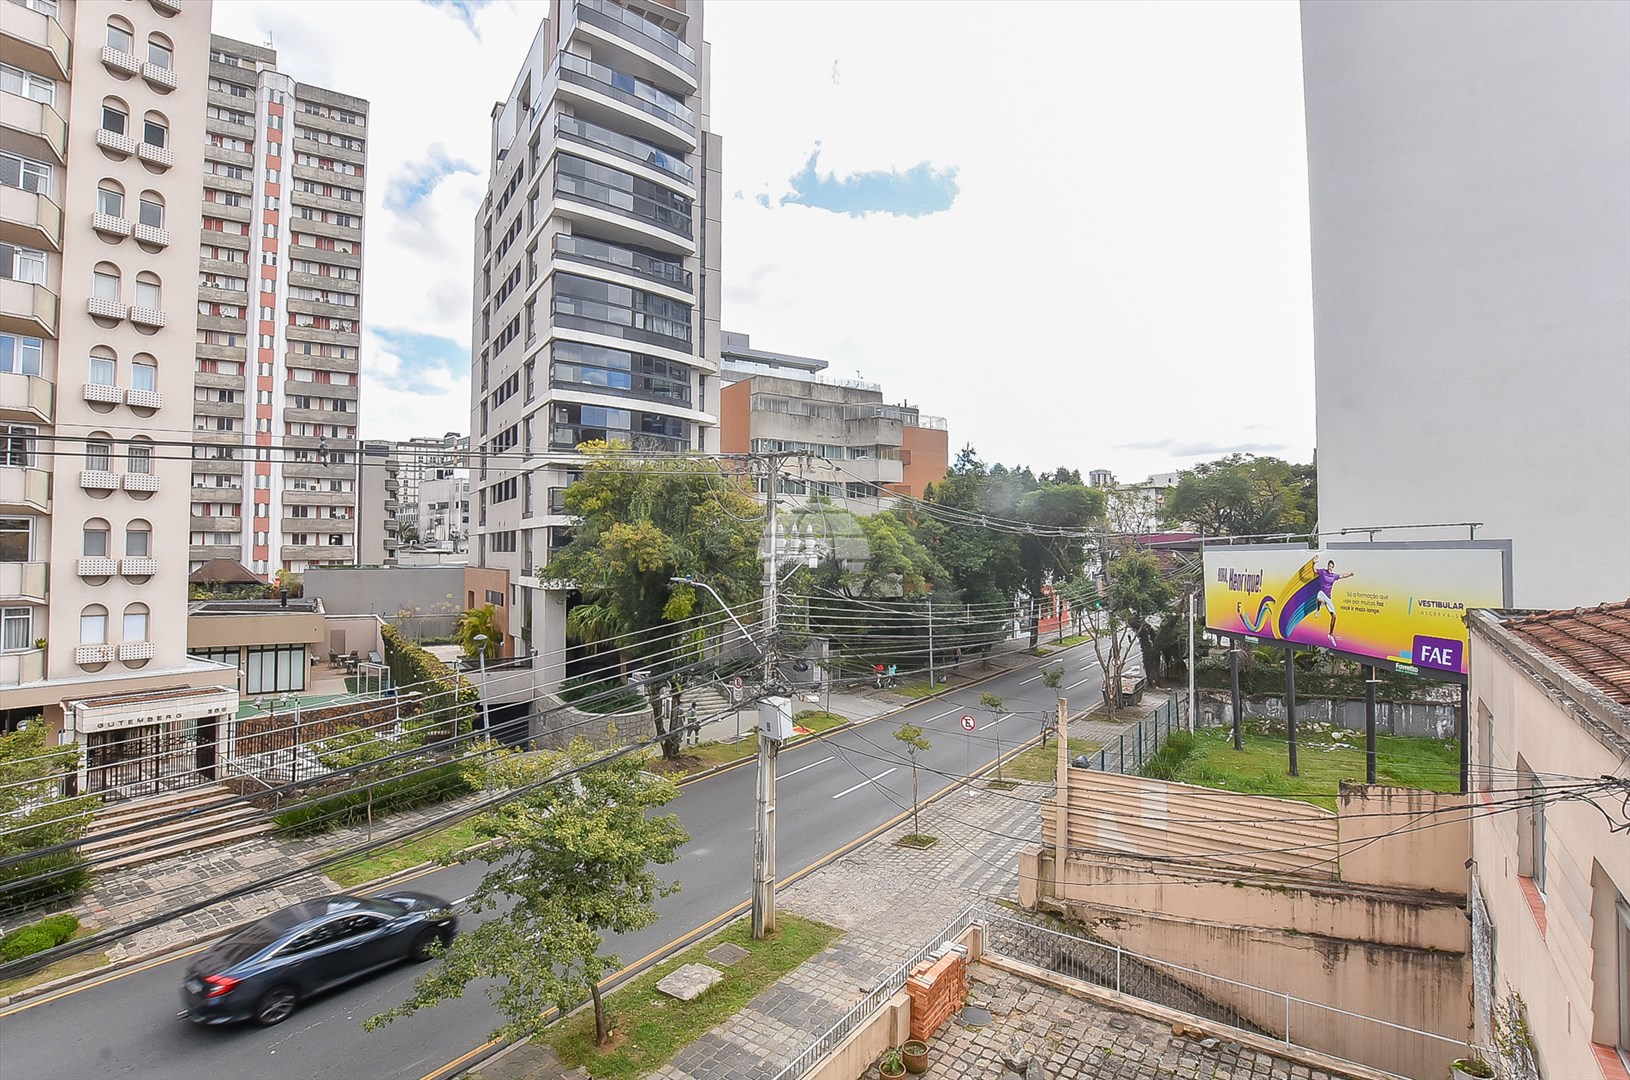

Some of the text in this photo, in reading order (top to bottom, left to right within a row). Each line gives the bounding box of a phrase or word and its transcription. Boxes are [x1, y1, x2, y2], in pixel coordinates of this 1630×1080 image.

[1228, 567, 1263, 596] Henrique!
[1417, 600, 1464, 610] VESTIBULAR
[1421, 645, 1454, 666] FAE
[97, 713, 182, 729] GUTEMBERG
